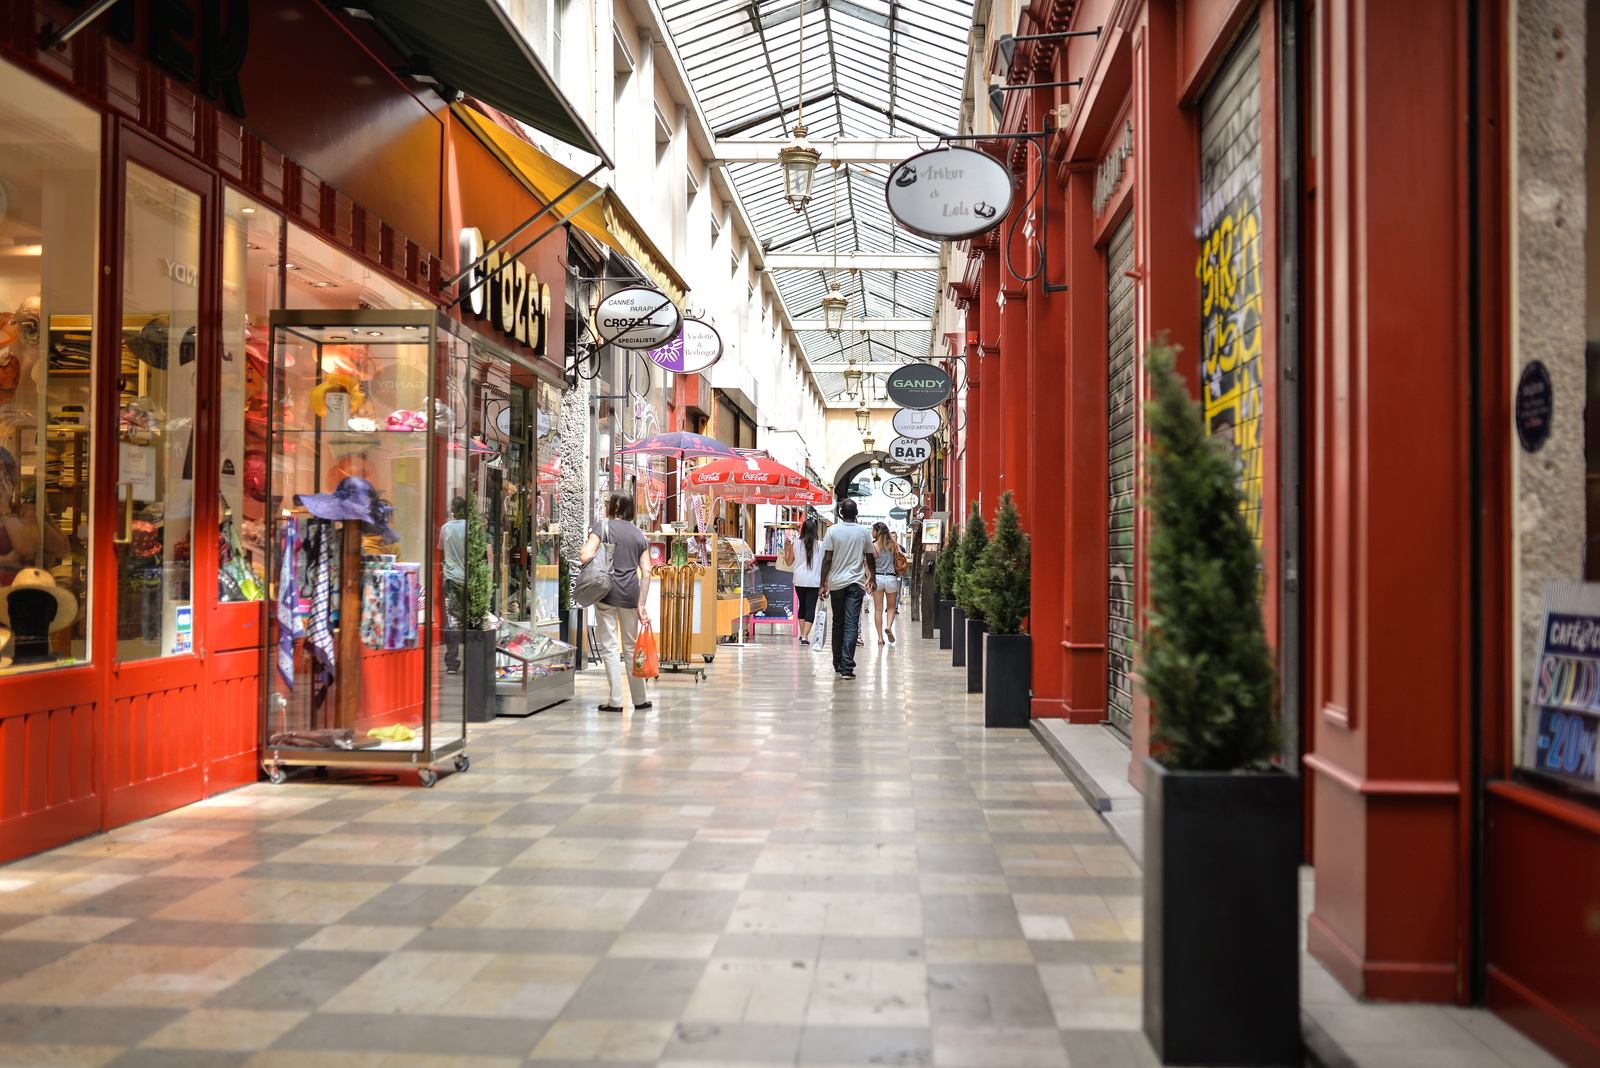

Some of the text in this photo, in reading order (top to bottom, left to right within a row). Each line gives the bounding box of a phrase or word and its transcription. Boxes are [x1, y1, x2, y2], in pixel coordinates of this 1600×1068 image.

[603, 317, 653, 327] CROZET
[892, 379, 946, 388] GANDY
[895, 446, 926, 459] BAR
